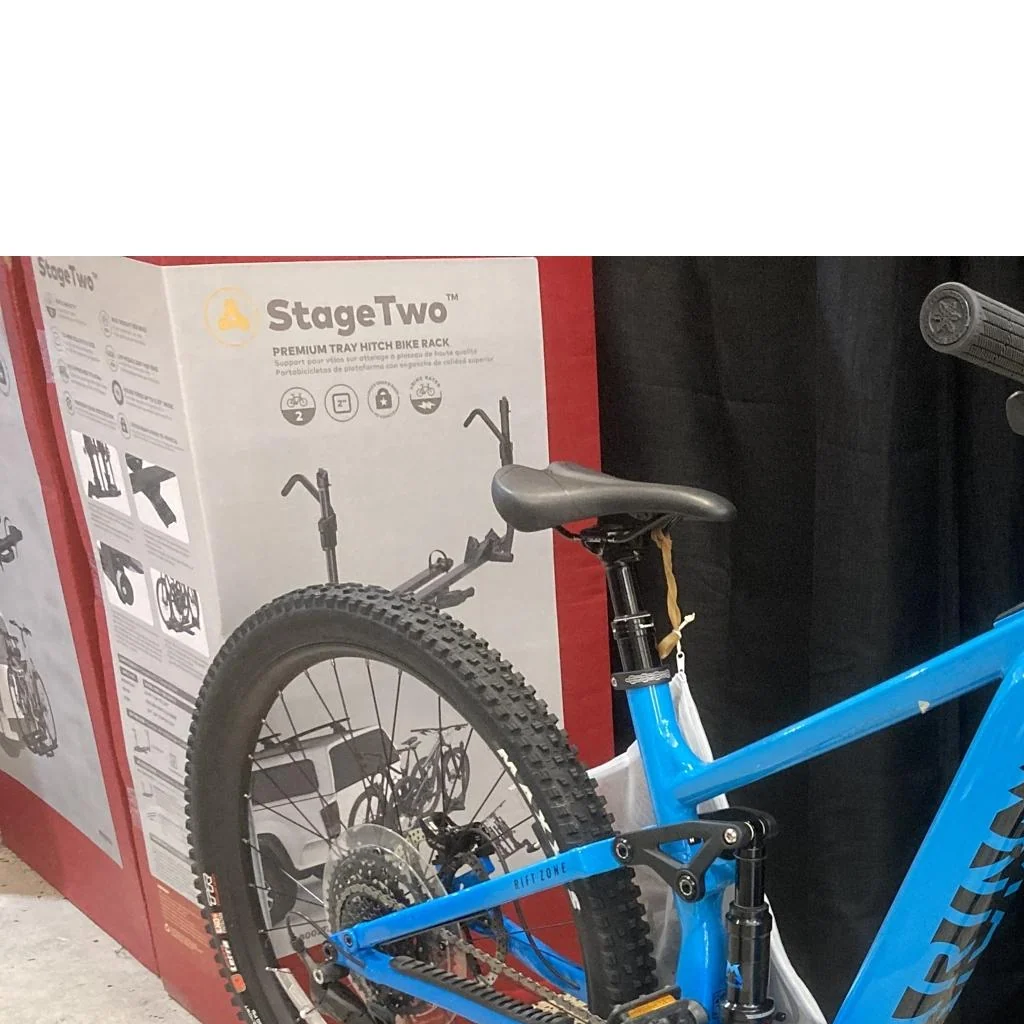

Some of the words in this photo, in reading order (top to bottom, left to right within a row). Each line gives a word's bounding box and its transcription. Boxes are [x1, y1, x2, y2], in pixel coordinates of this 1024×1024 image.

[37, 257, 94, 291] StageTwo
[266, 295, 448, 337] StageTwo
[272, 345, 327, 356] PREMIUM
[329, 343, 357, 354] TRAY
[360, 341, 393, 352] HITCH
[395, 339, 419, 350] BIKE
[421, 338, 450, 348] RACK
[274, 359, 305, 368] Support
[295, 411, 304, 422] 2
[513, 872, 536, 890] RIFT
[540, 862, 567, 882] ZONE
